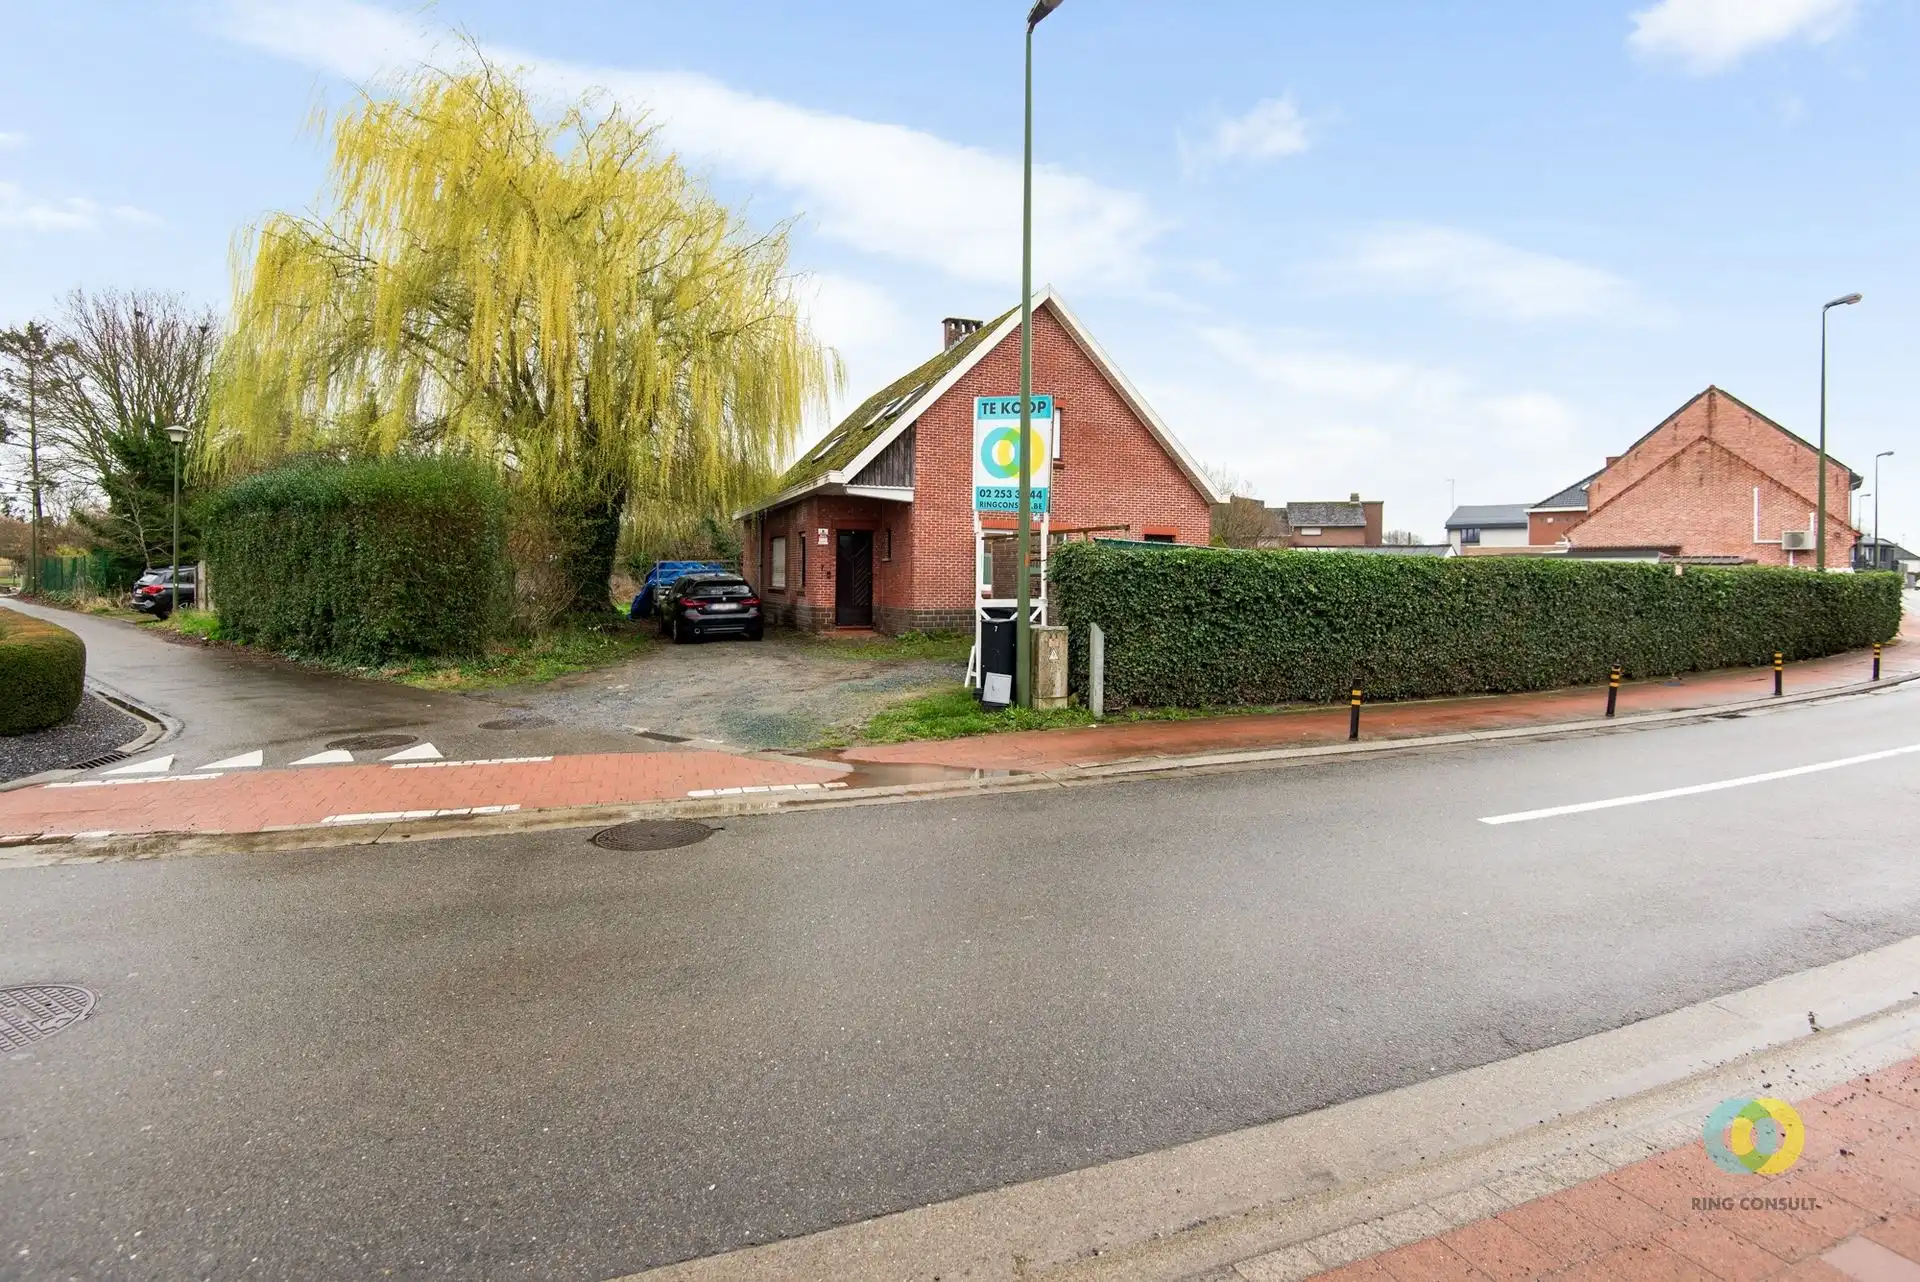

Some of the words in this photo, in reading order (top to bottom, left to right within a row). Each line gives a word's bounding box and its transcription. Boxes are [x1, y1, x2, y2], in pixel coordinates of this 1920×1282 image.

[982, 402, 996, 415] TE
[979, 489, 992, 498] 02
[994, 489, 1012, 499] 253
[979, 501, 1043, 510] RINGCONS.BE
